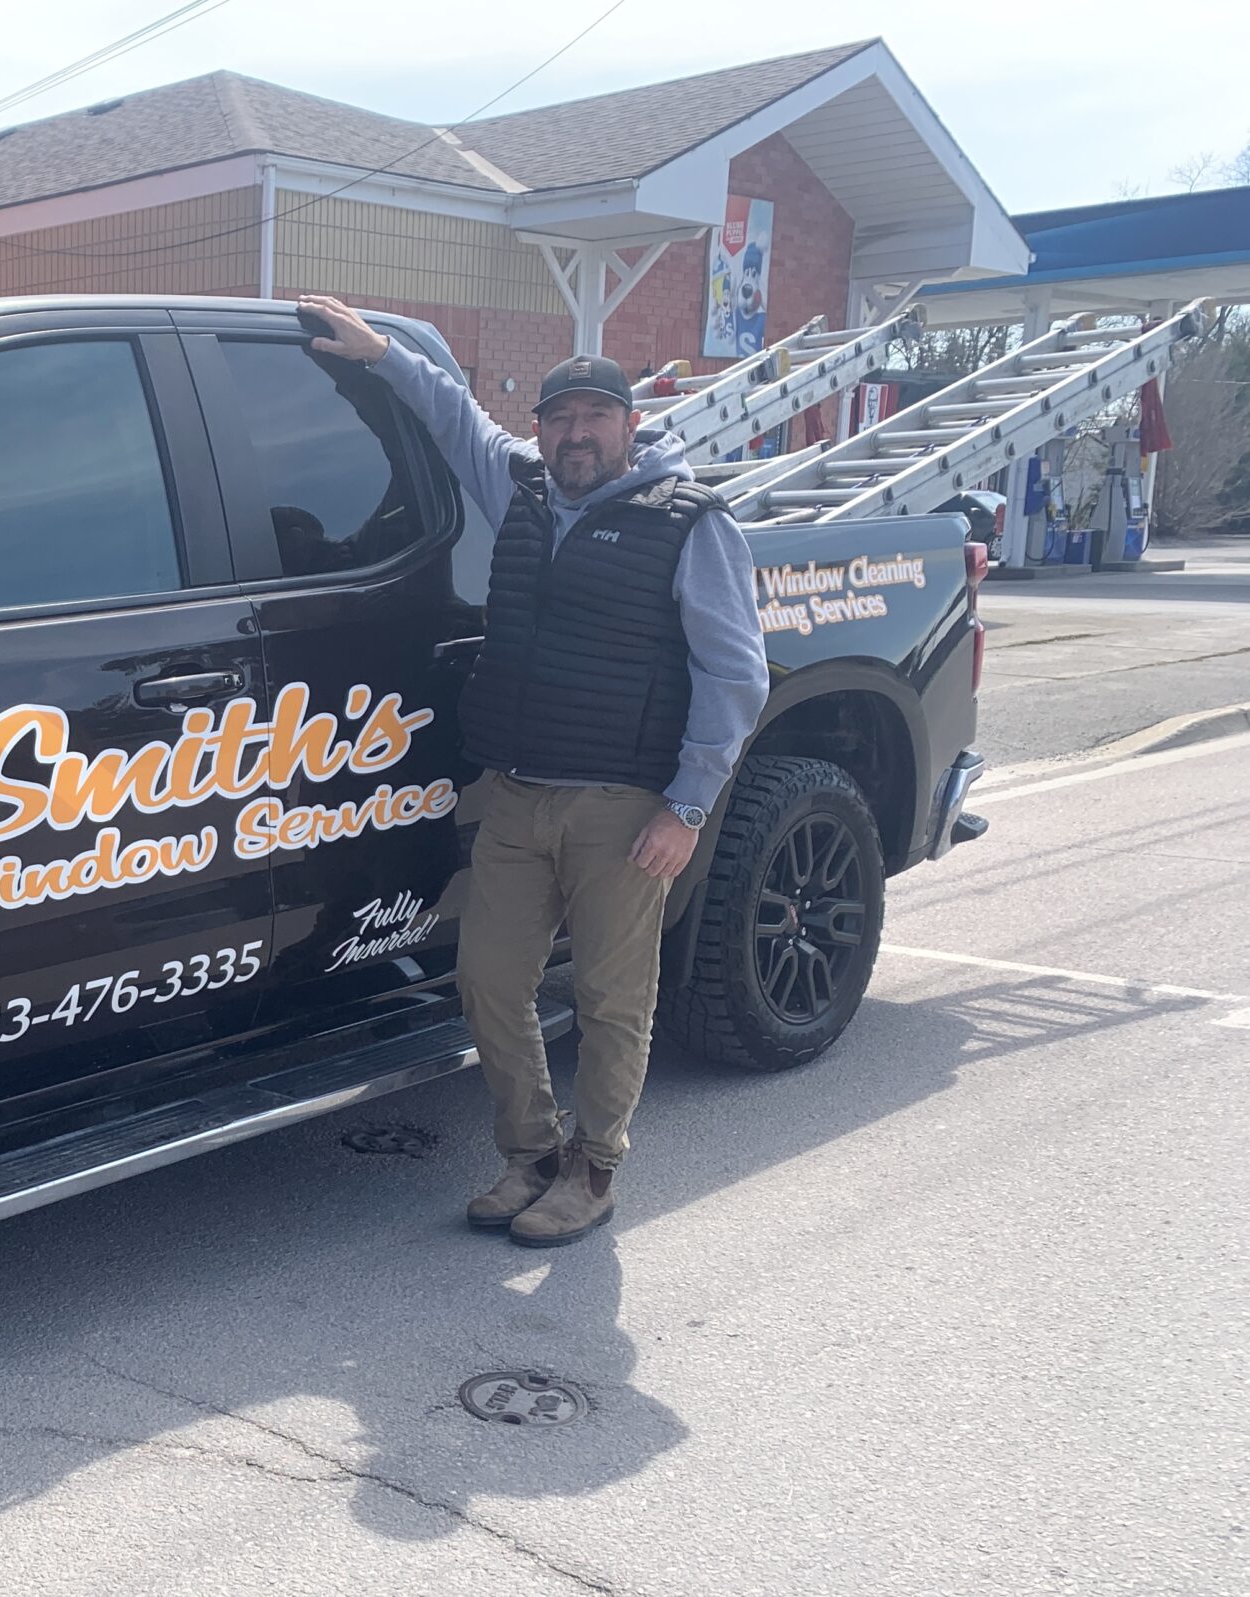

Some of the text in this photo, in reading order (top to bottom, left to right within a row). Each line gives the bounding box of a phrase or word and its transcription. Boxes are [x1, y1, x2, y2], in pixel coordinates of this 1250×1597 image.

[761, 560, 845, 598] Window
[848, 552, 926, 588] Cleaning
[758, 589, 888, 635] nting Services
[233, 777, 459, 861] Service
[353, 889, 424, 935] Fully
[324, 913, 439, 972] Insured!
